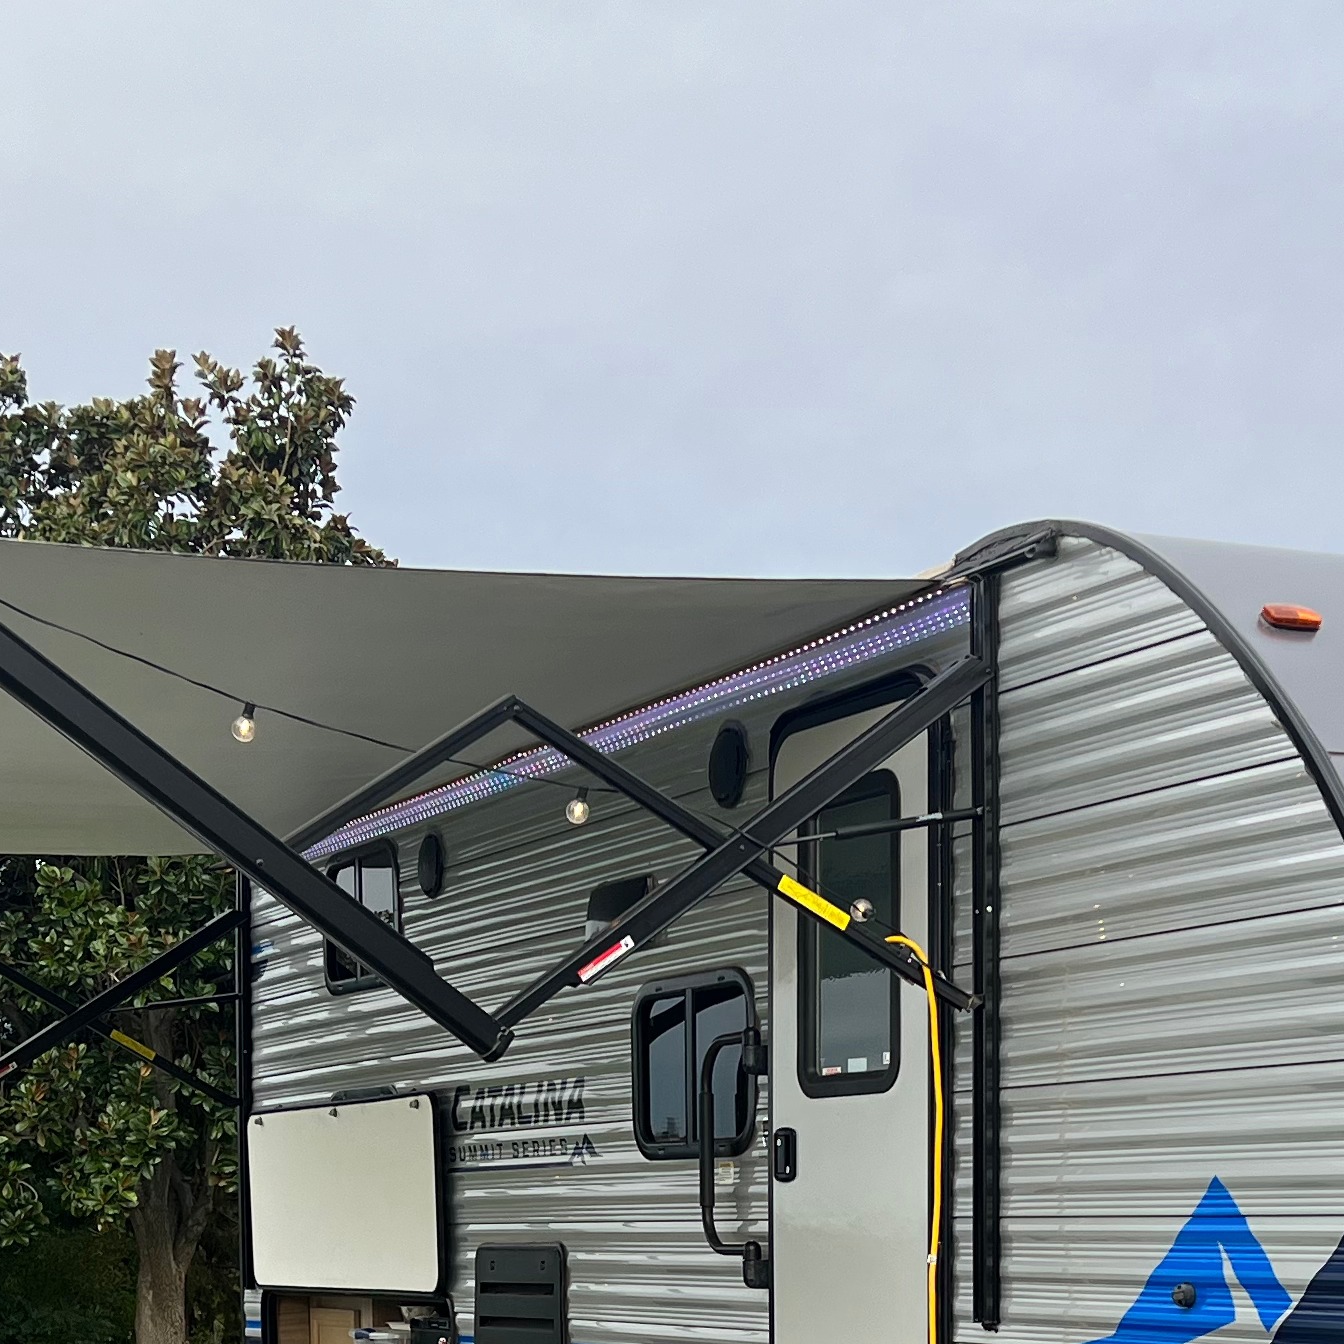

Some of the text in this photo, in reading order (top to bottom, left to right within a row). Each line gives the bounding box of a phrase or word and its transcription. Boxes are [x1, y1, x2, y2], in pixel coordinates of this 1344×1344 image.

[451, 1076, 586, 1132] CATALINA
[449, 1138, 568, 1163] SUMMIT SERIES
